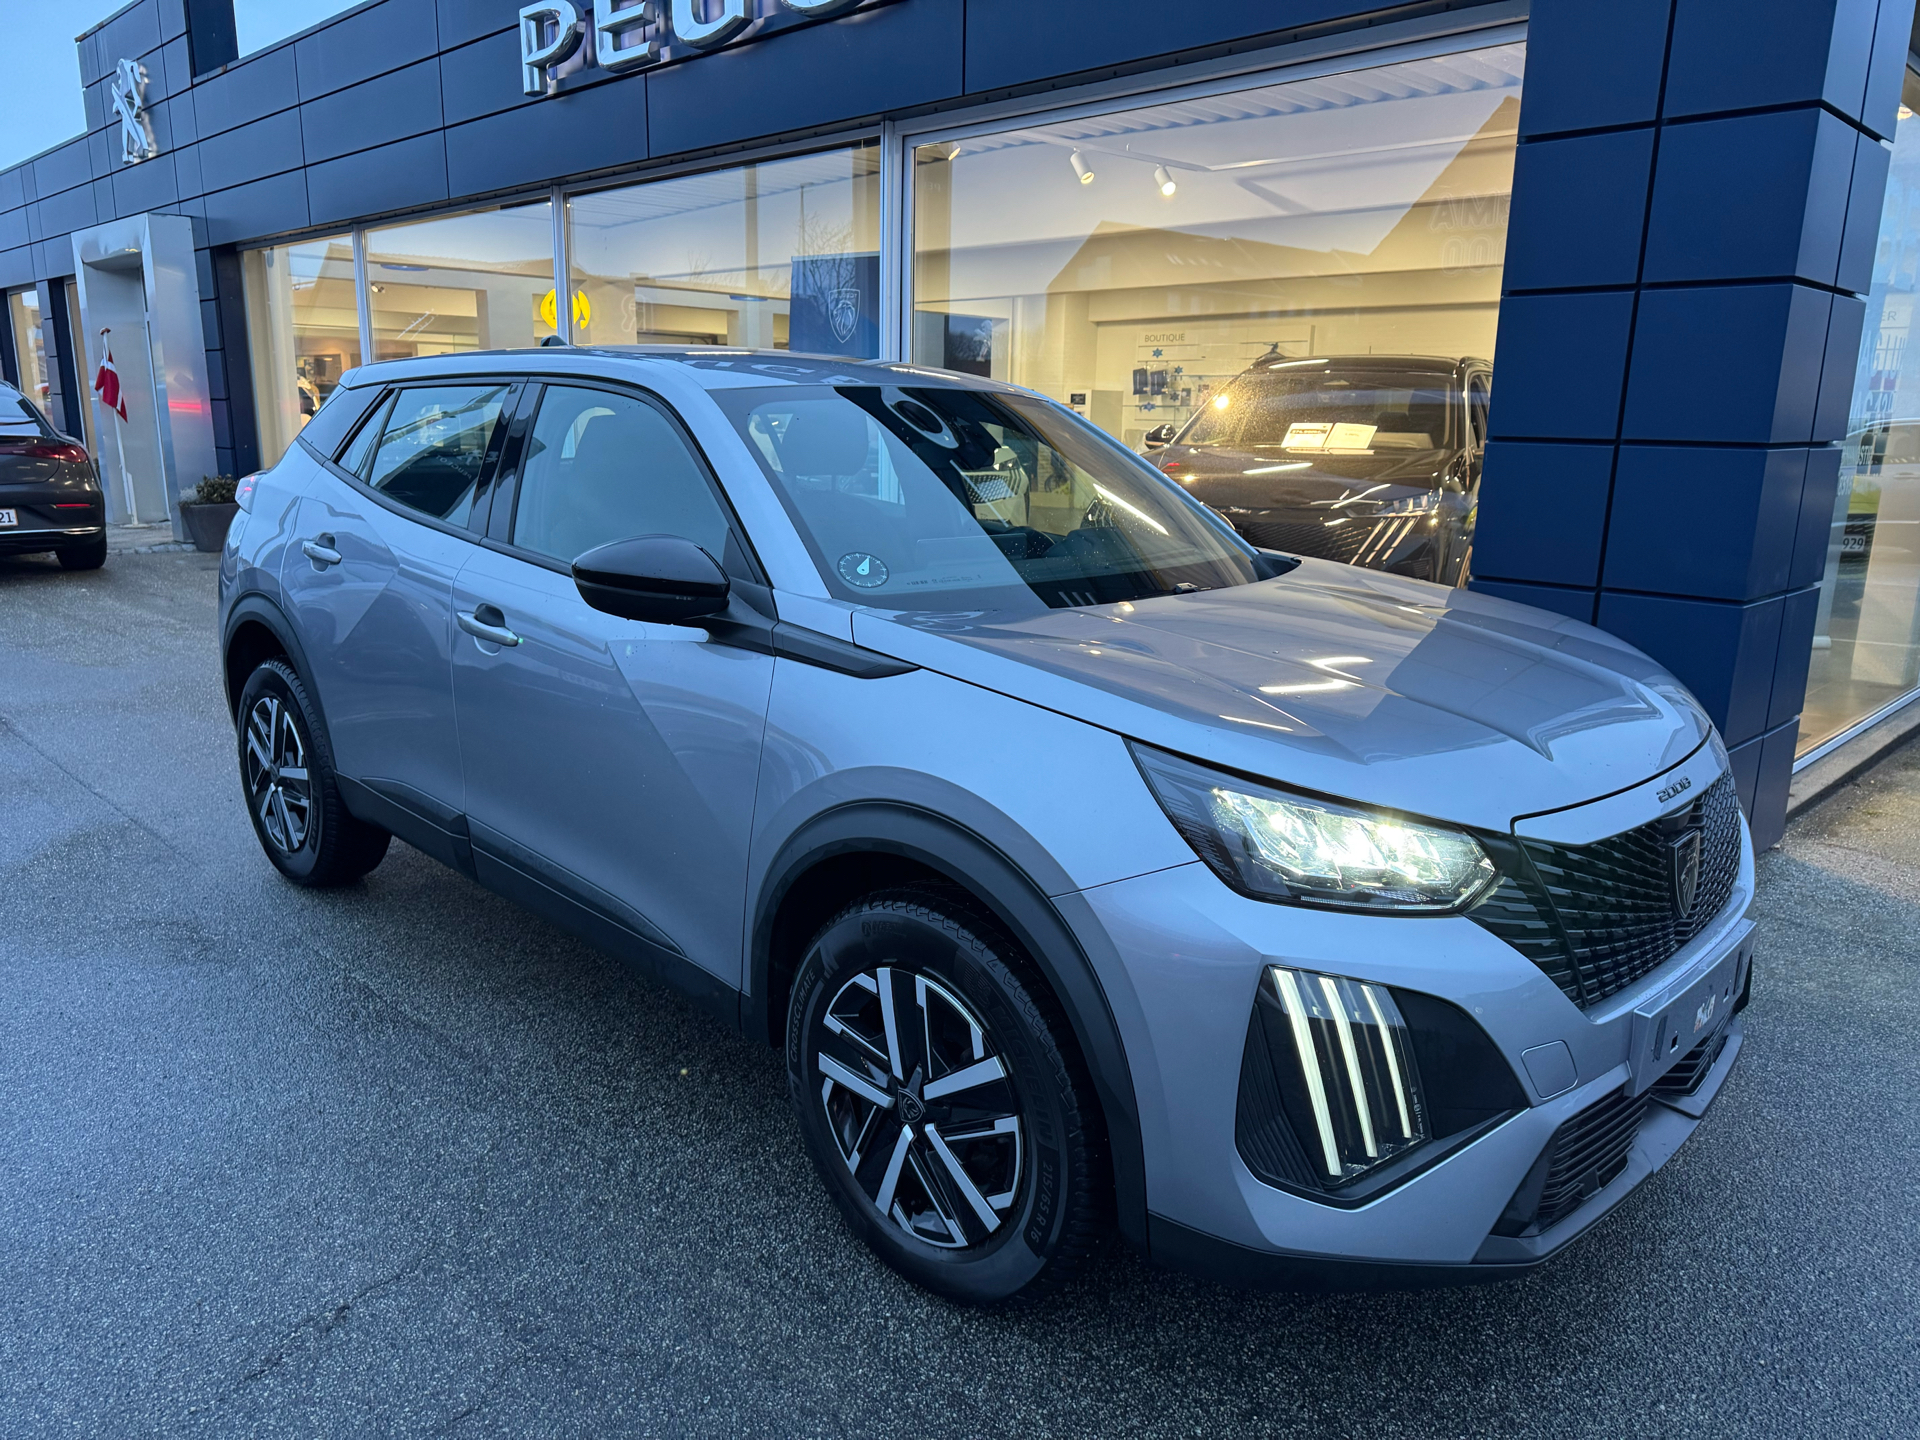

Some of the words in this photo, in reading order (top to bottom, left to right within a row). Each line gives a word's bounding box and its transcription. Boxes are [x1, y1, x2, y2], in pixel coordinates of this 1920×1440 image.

[519, 0, 866, 97] PEU
[1144, 333, 1186, 342] BOUTIQUE
[1656, 776, 1691, 803] 2008
[789, 968, 816, 1063] CROSSCLIMATE
